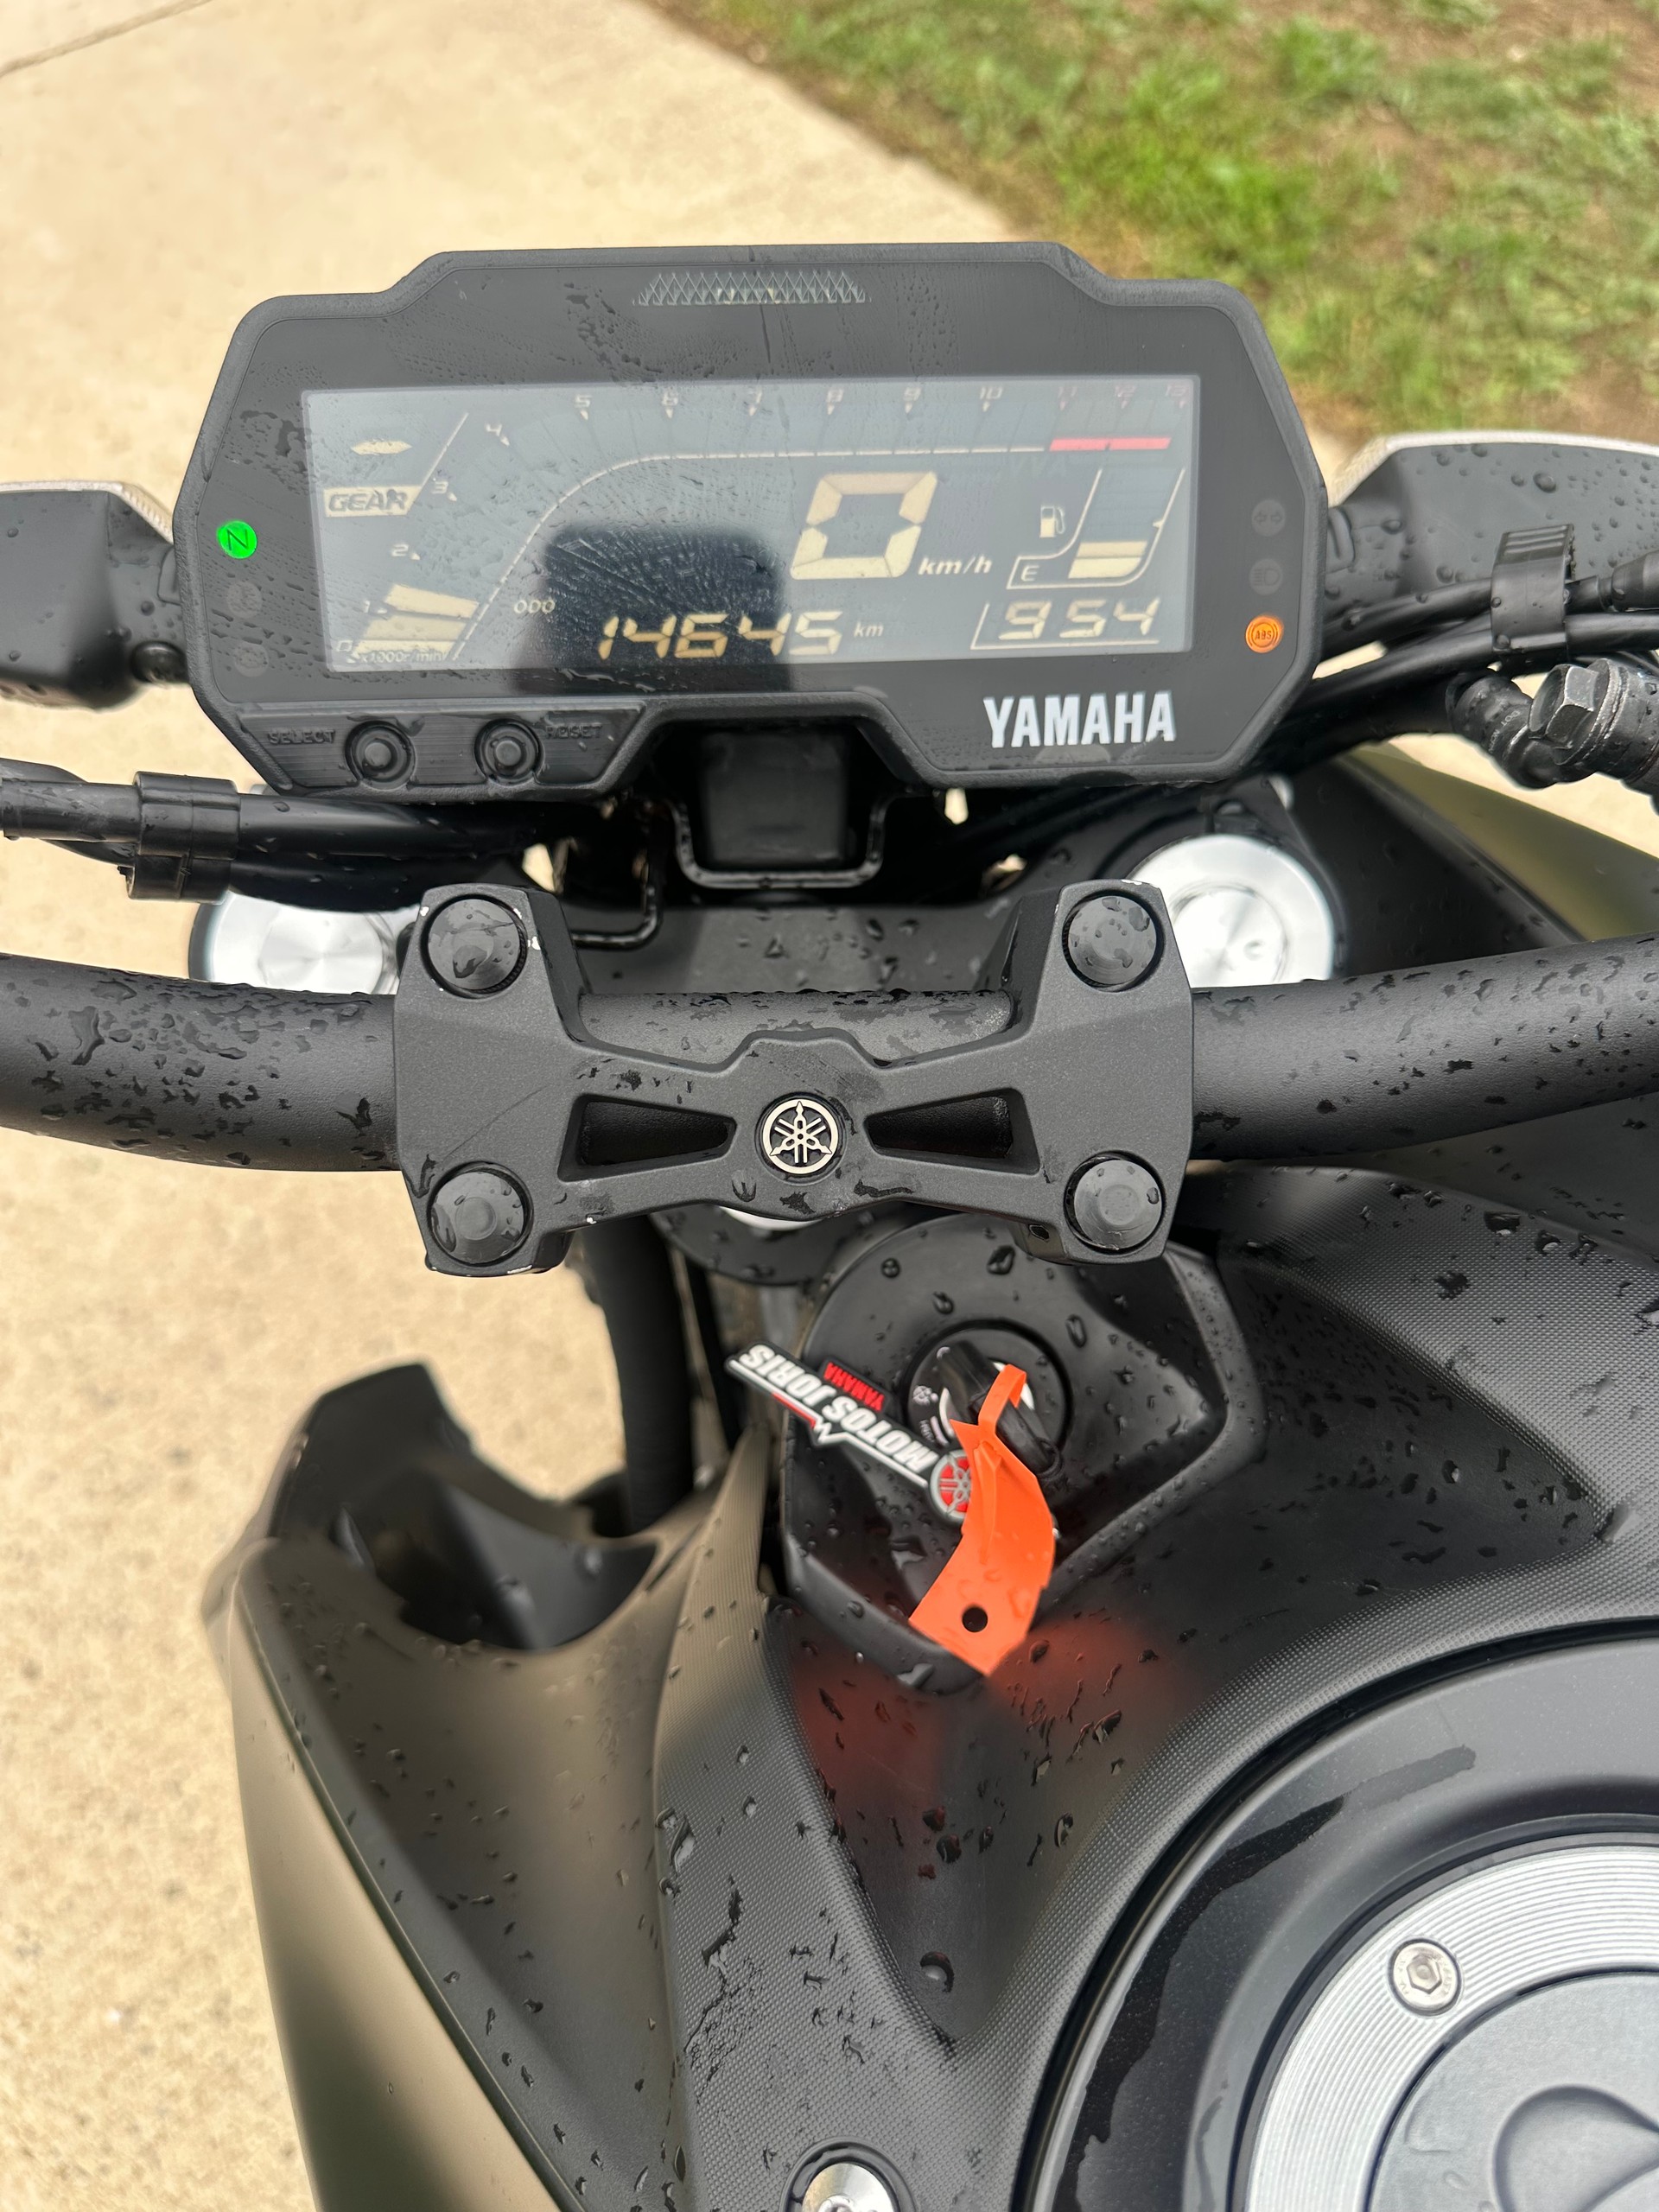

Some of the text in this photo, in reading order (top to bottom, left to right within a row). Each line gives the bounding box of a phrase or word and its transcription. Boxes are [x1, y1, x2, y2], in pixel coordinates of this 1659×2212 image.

[574, 394, 593, 409] 5
[979, 386, 1003, 400] 10
[485, 423, 503, 436] 4
[432, 480, 449, 495] 3
[327, 490, 408, 512] GEAR
[791, 471, 938, 580] 0
[226, 528, 249, 551] N
[391, 543, 410, 557] 2
[918, 555, 993, 575] km/h
[1021, 565, 1039, 582] E
[598, 611, 843, 660] 14645
[854, 621, 885, 638] km
[1254, 628, 1273, 641] ABS
[982, 690, 1177, 749] YAMAHA
[267, 728, 336, 746] SELECT
[545, 722, 603, 740] RESET
[823, 1361, 886, 1413] YAMAHA
[739, 1344, 939, 1474] MOTOS JORIS
